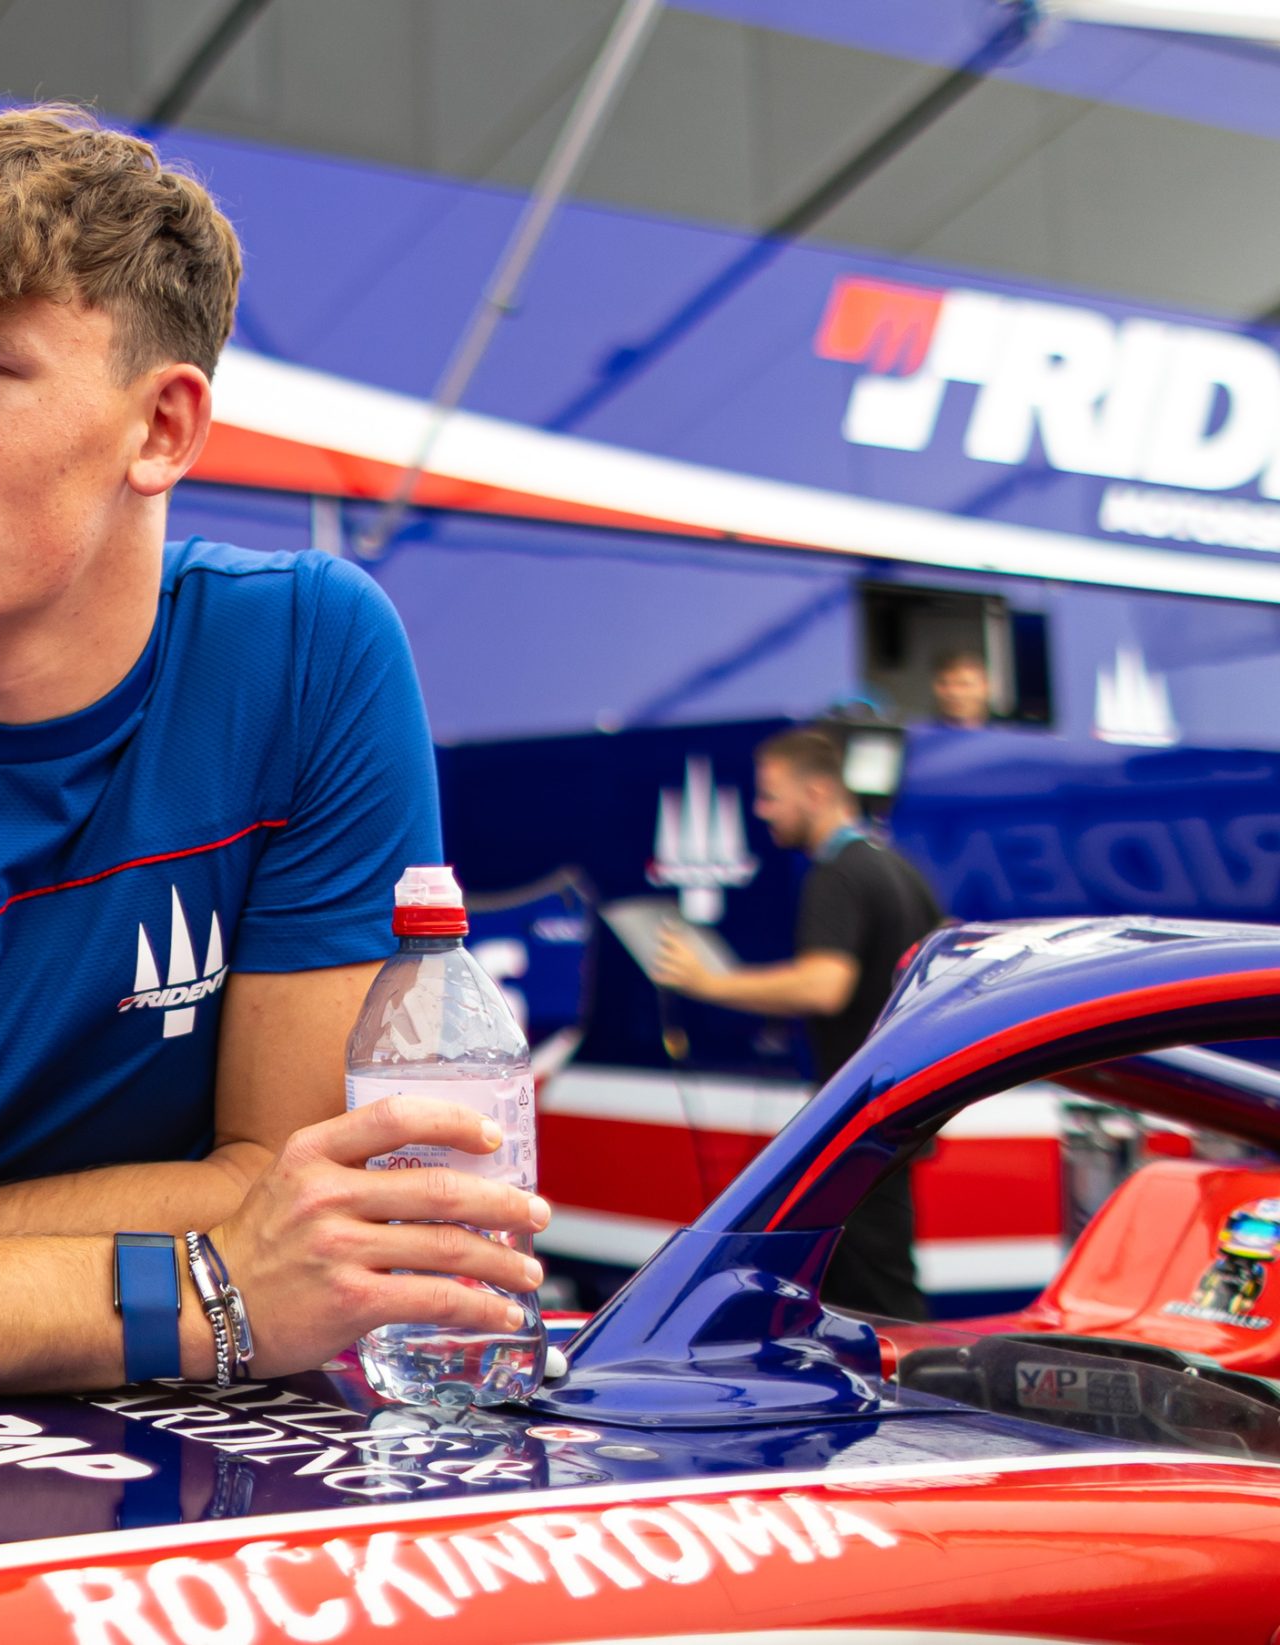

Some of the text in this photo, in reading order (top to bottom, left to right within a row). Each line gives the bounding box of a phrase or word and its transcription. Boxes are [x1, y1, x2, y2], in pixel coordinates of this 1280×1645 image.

[815, 274, 1280, 501] TRID
[117, 964, 229, 1013] TRIDENT
[387, 1156, 422, 1171] 200
[76, 1384, 449, 1497] ARDING
[153, 1377, 471, 1457] AYLIS
